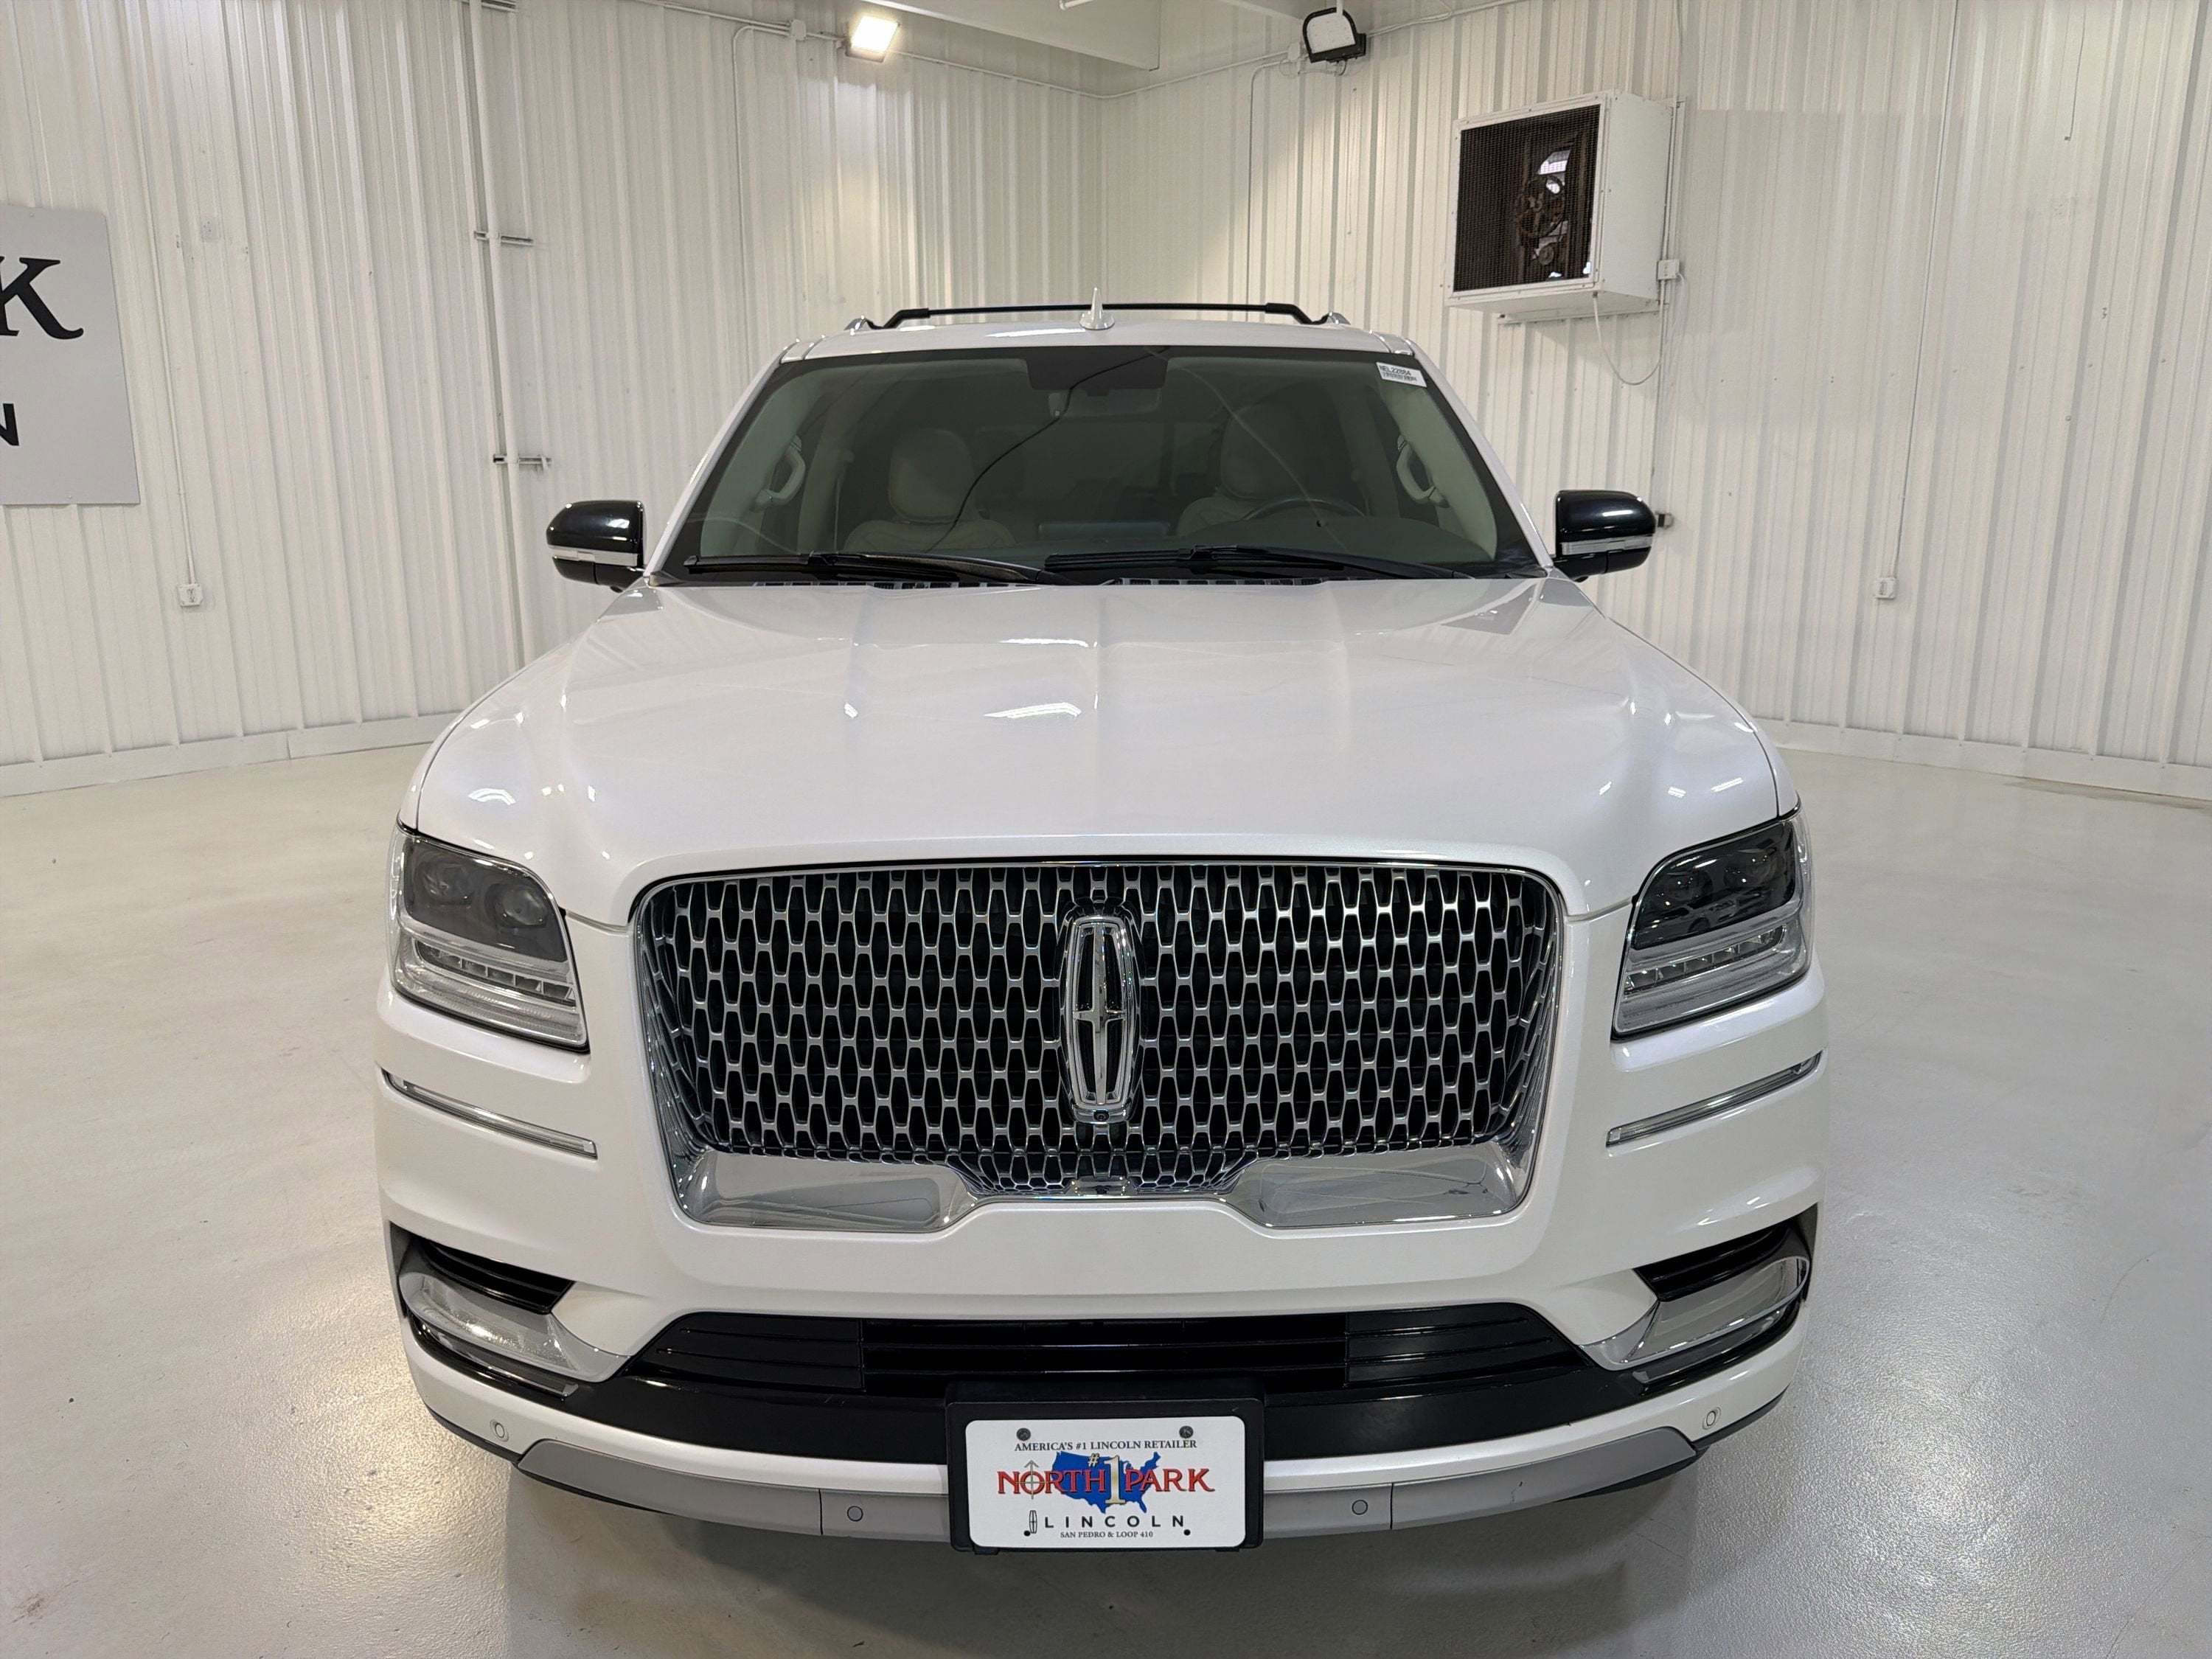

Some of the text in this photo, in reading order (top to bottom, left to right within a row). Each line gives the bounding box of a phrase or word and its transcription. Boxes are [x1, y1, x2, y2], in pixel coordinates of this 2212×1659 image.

[1014, 1439, 1197, 1451] AMERICA'S #1 LINCOLN RETAILER
[997, 1469, 1105, 1495] NORTH
[1124, 1468, 1215, 1492] PARK
[1044, 1515, 1184, 1528] LINCOLN
